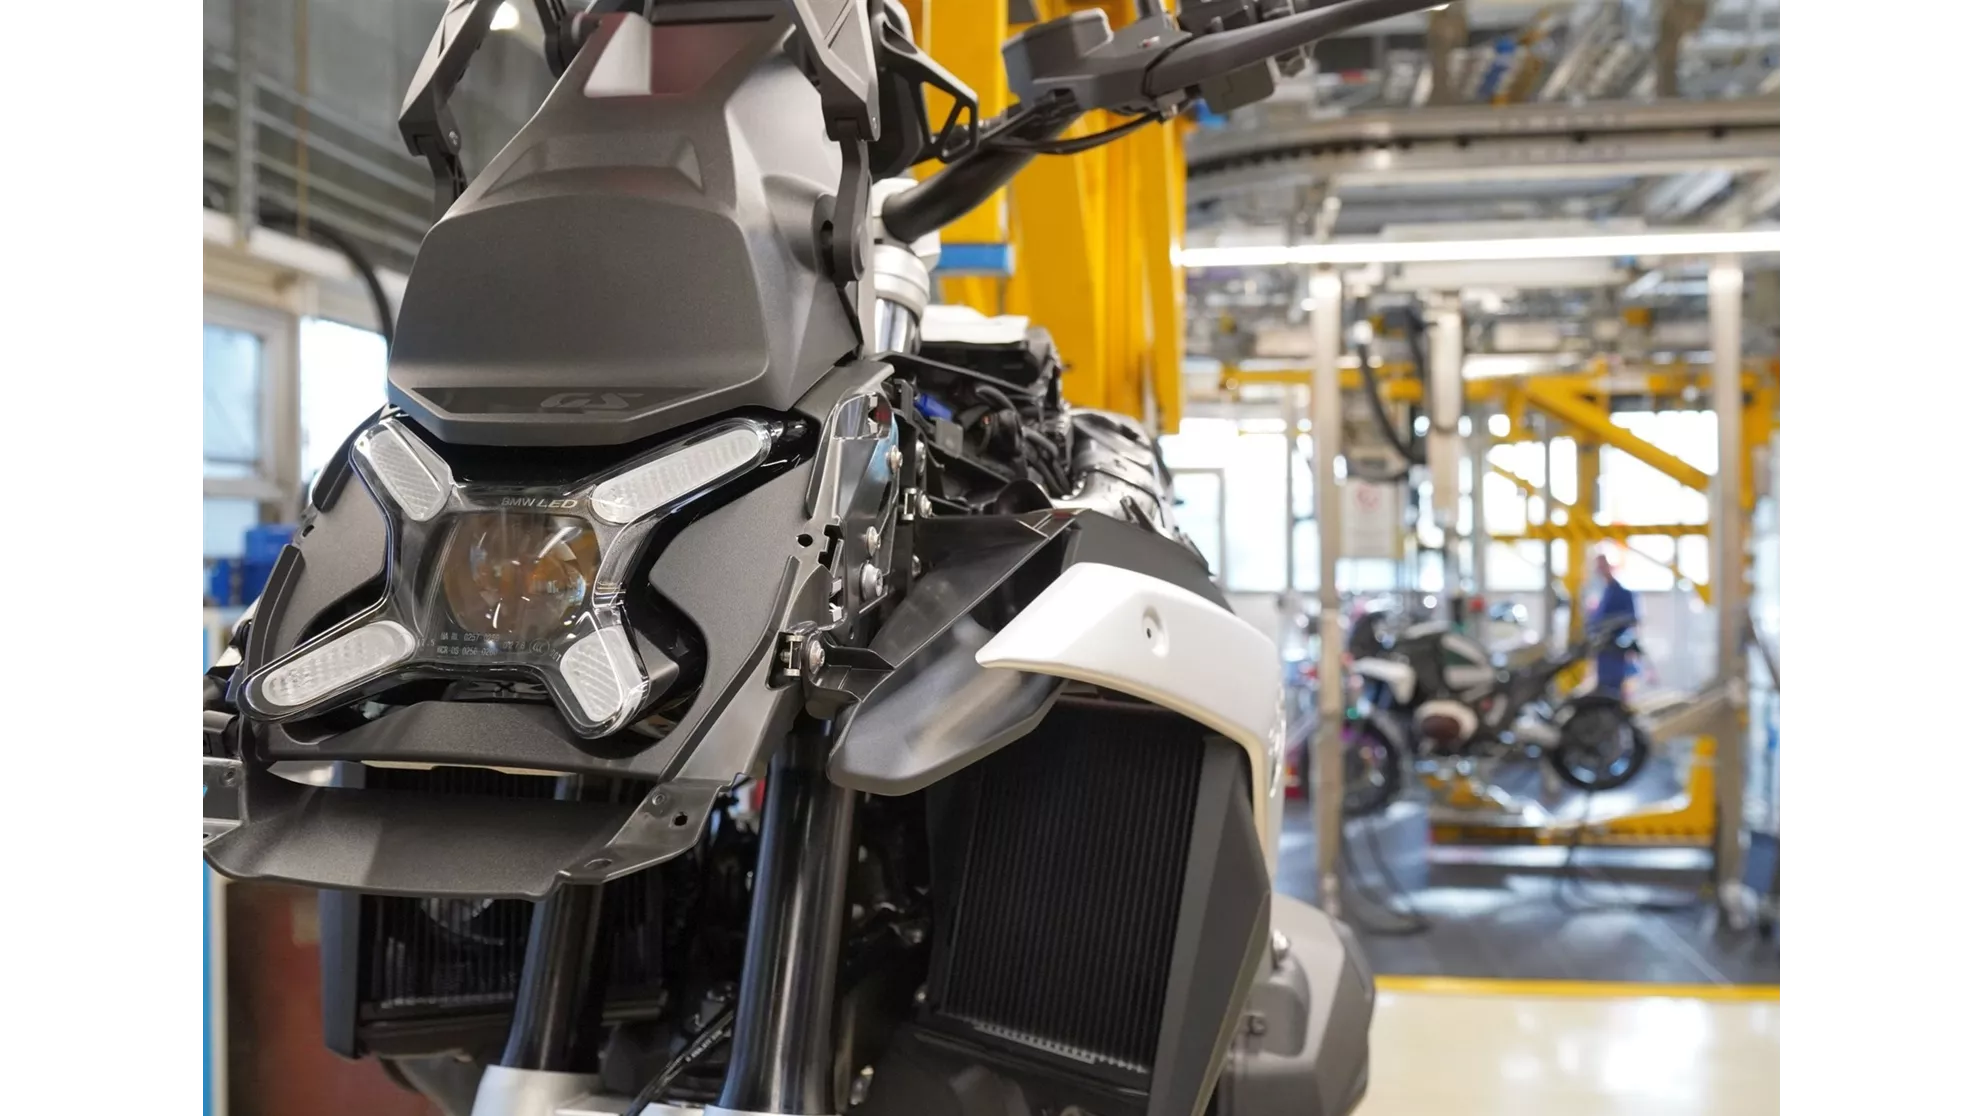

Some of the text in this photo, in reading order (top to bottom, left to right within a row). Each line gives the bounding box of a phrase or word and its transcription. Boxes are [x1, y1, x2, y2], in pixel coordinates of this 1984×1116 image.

[540, 392, 644, 409] GS
[500, 496, 578, 509] BMW LED
